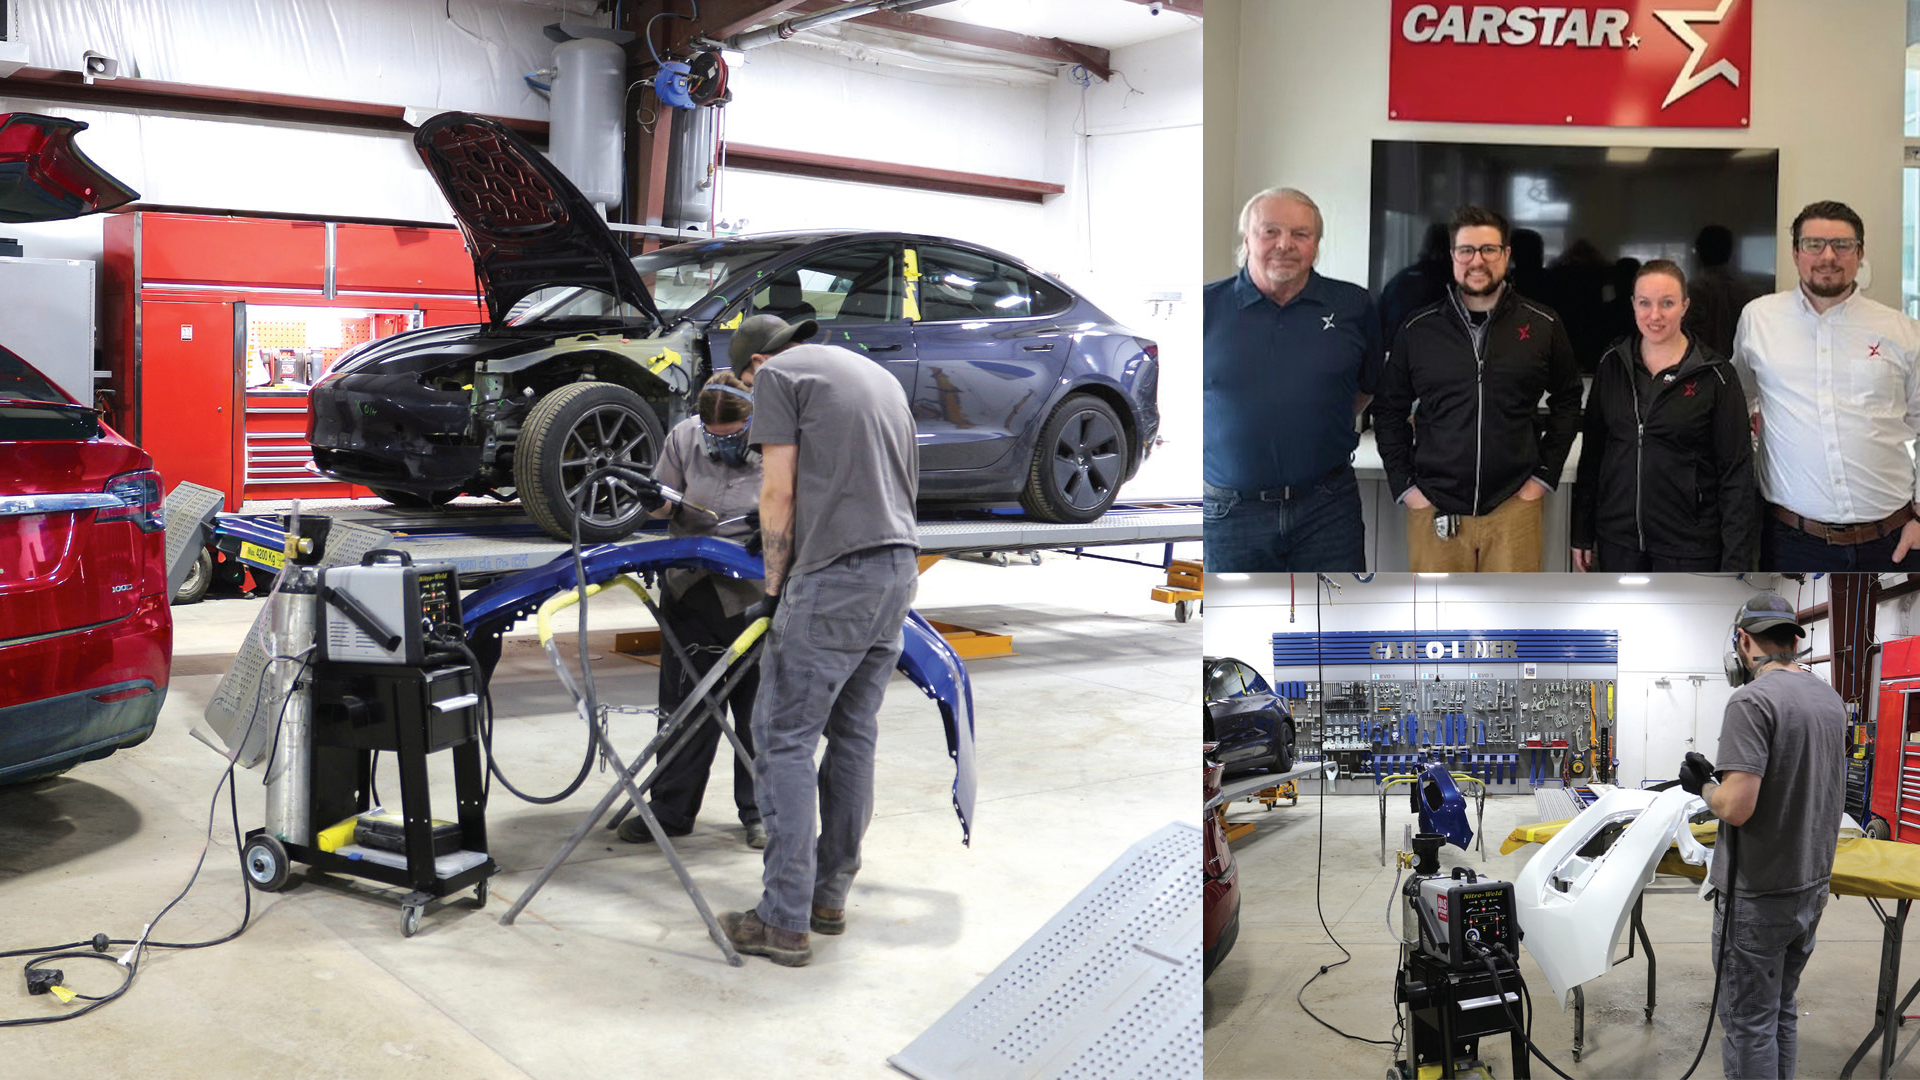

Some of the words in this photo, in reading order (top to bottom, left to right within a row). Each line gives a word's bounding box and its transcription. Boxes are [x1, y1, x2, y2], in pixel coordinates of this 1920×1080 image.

[1402, 4, 1630, 47] CARSTAR
[256, 548, 268, 561] 4200
[268, 550, 276, 567] Kg
[1369, 641, 1518, 659] CAR-O-LINER
[1463, 890, 1503, 899] Nitro-Weld
